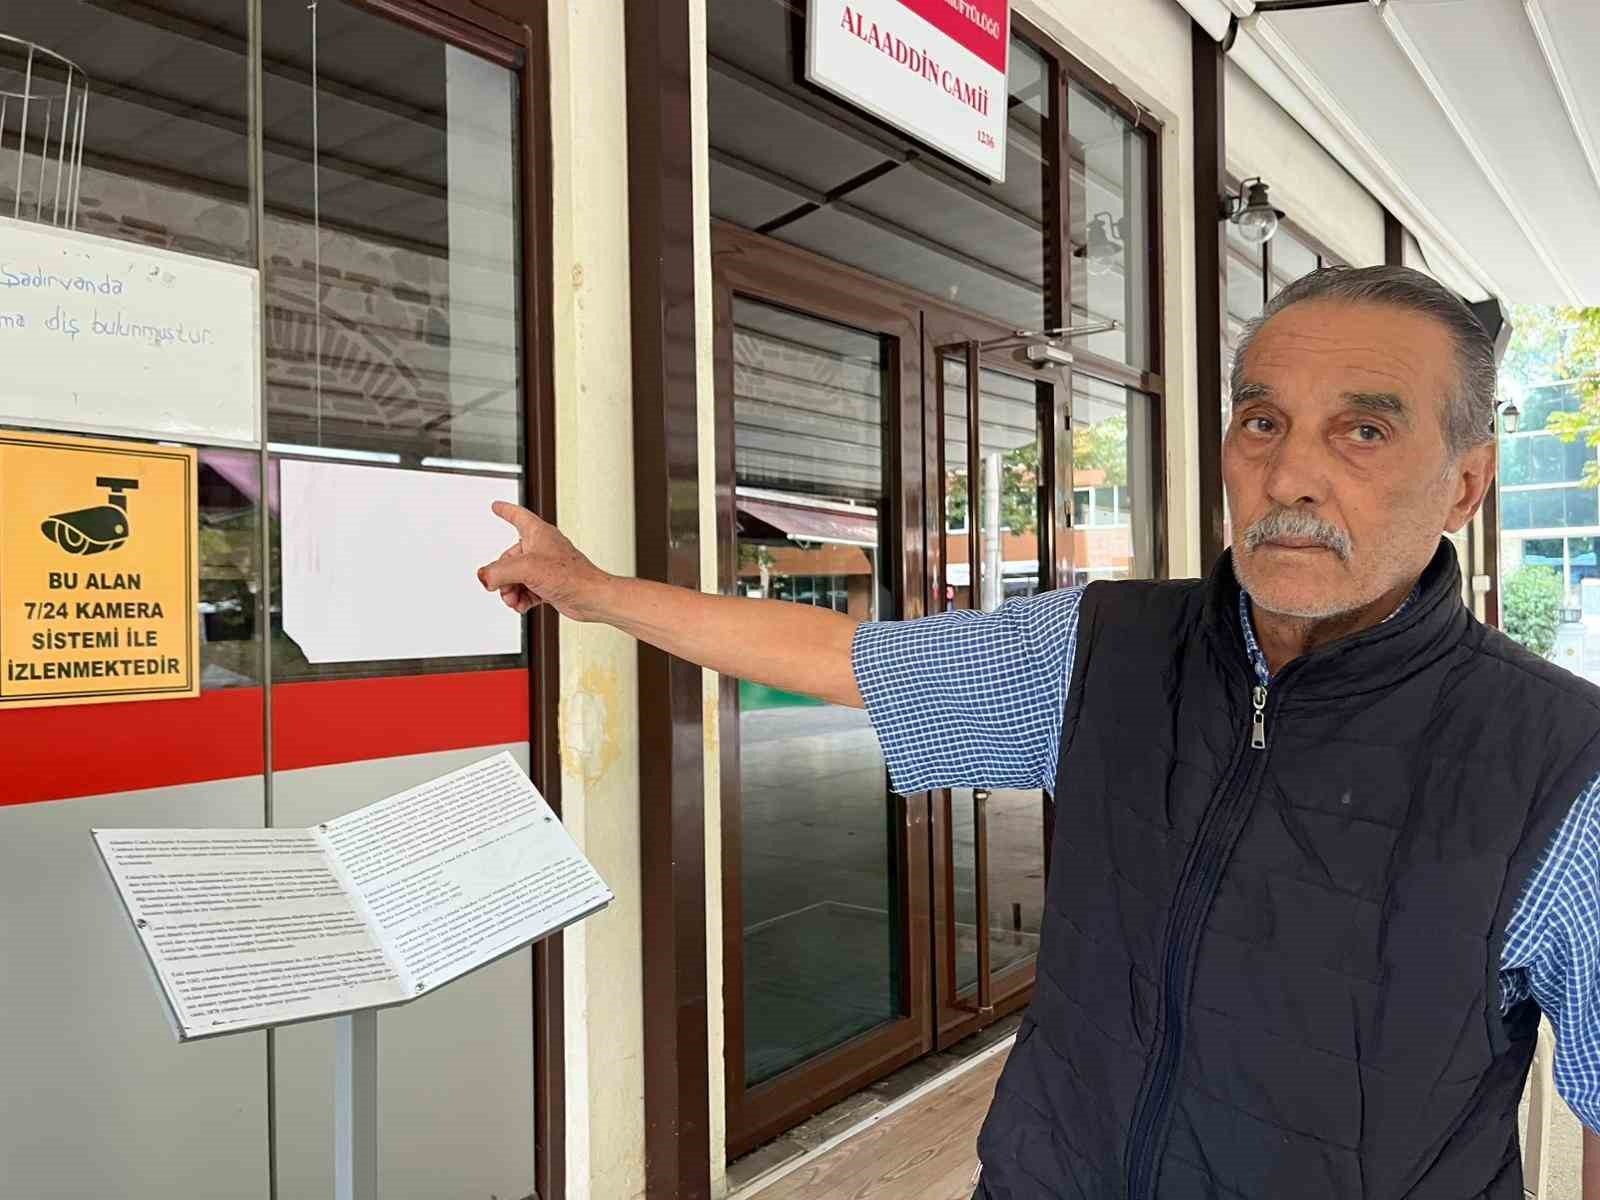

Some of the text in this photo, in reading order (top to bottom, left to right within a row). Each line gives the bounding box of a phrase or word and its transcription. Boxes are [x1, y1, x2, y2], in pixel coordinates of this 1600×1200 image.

[841, 5, 939, 86] ALAADDİN
[49, 572, 141, 590] BU ALAN
[24, 602, 164, 620] 7/24 KAMERA
[32, 627, 158, 650] SİSTEMİ İLE
[8, 655, 180, 681] İZLENMEKTEDİR
